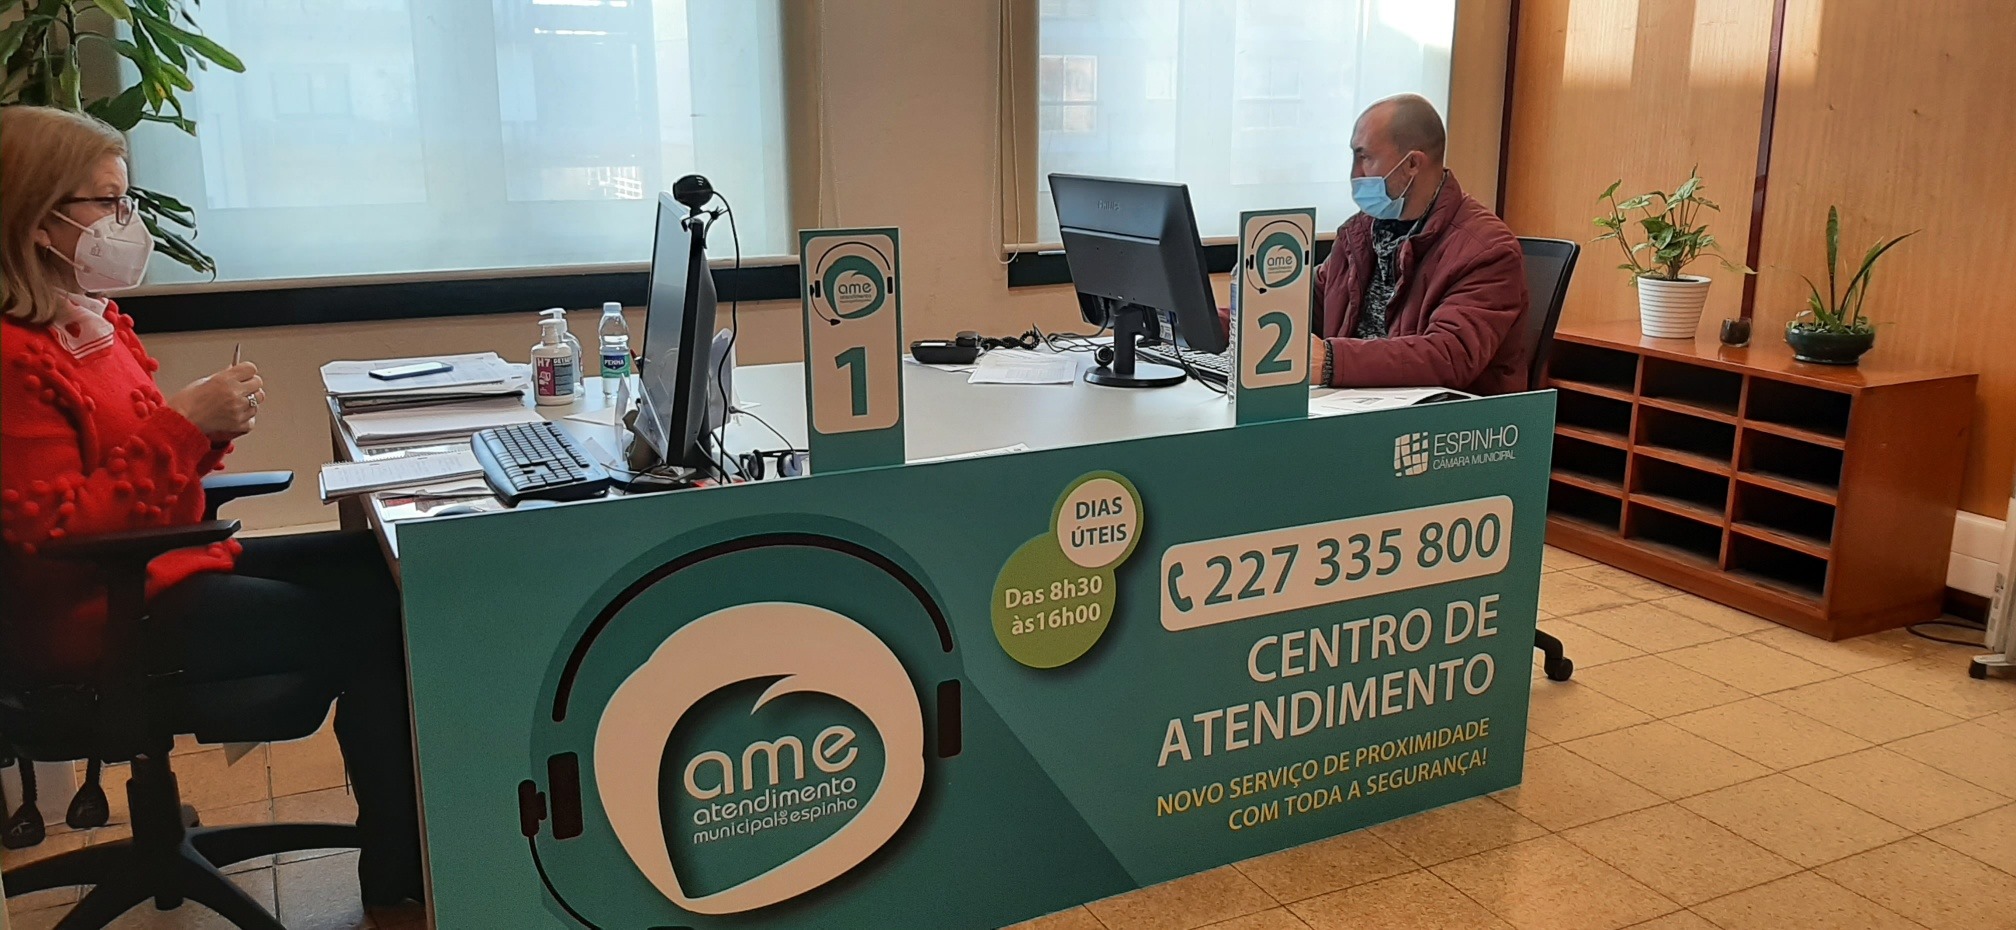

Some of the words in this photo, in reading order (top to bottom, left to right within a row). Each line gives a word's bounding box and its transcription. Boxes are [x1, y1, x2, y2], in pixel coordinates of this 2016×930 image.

[1267, 255, 1293, 266] ame
[838, 283, 872, 294] ame
[1255, 311, 1292, 375] 2
[834, 346, 868, 417] 1
[1433, 456, 1470, 470] CÂMARA
[1472, 450, 1516, 465] MUNICIPAL
[1434, 424, 1519, 456] ESPINHO
[1076, 496, 1123, 520] DIAS
[1071, 523, 1127, 548] ÚTEIS
[1204, 543, 1299, 606] 227
[1314, 528, 1402, 586] 335
[1416, 513, 1501, 568] 800
[1005, 588, 1045, 608] Das
[1050, 575, 1103, 600] 8h30
[1247, 607, 1433, 682] CENTRO
[1444, 593, 1500, 644] DE
[1157, 653, 1495, 767] ATENDIMENTO
[684, 725, 858, 800] ame
[1156, 782, 1224, 817] NOVO
[1229, 760, 1318, 800] SERVIÇO
[1324, 751, 1350, 776] DE
[1355, 717, 1490, 768] PROXIMIDADE
[693, 777, 856, 826] atendimento
[1228, 800, 1279, 831] COM
[1284, 784, 1342, 816] TODA
[1347, 779, 1361, 800] A
[1366, 747, 1488, 797] SEGURANÇA!
[693, 812, 778, 844] municipal
[790, 798, 858, 822] espinho
